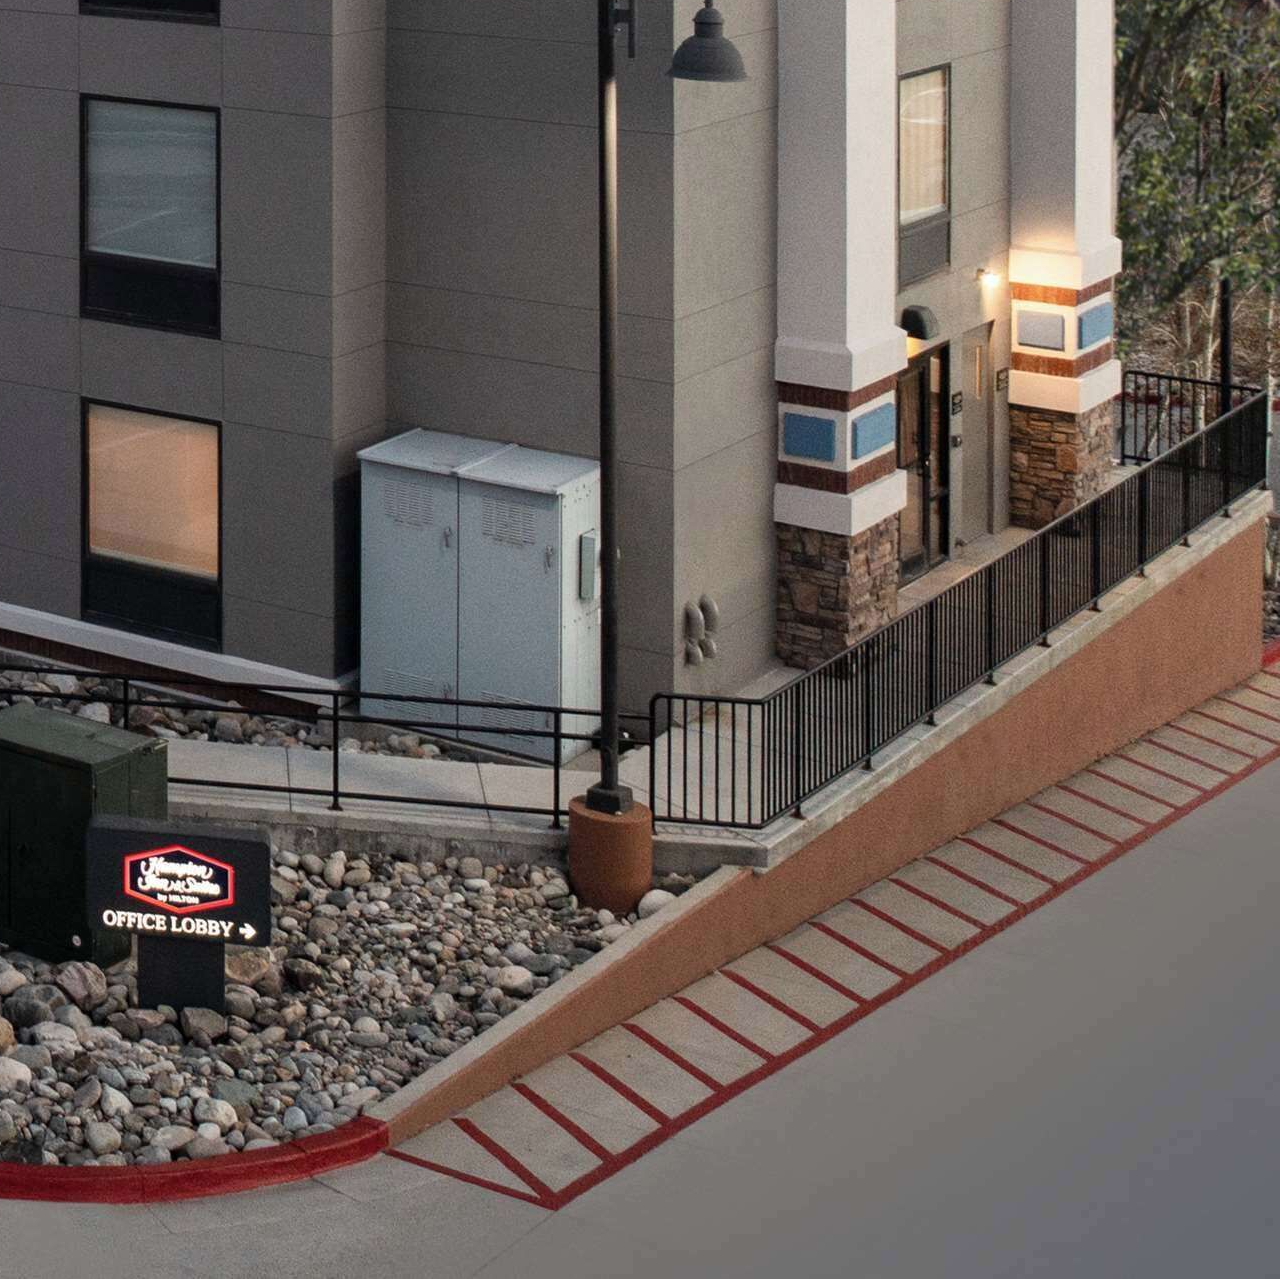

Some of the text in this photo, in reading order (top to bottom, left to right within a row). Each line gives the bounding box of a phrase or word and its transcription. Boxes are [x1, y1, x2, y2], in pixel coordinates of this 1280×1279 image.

[140, 856, 213, 879] Hampton
[102, 909, 234, 938] OFFICE LOBBY
